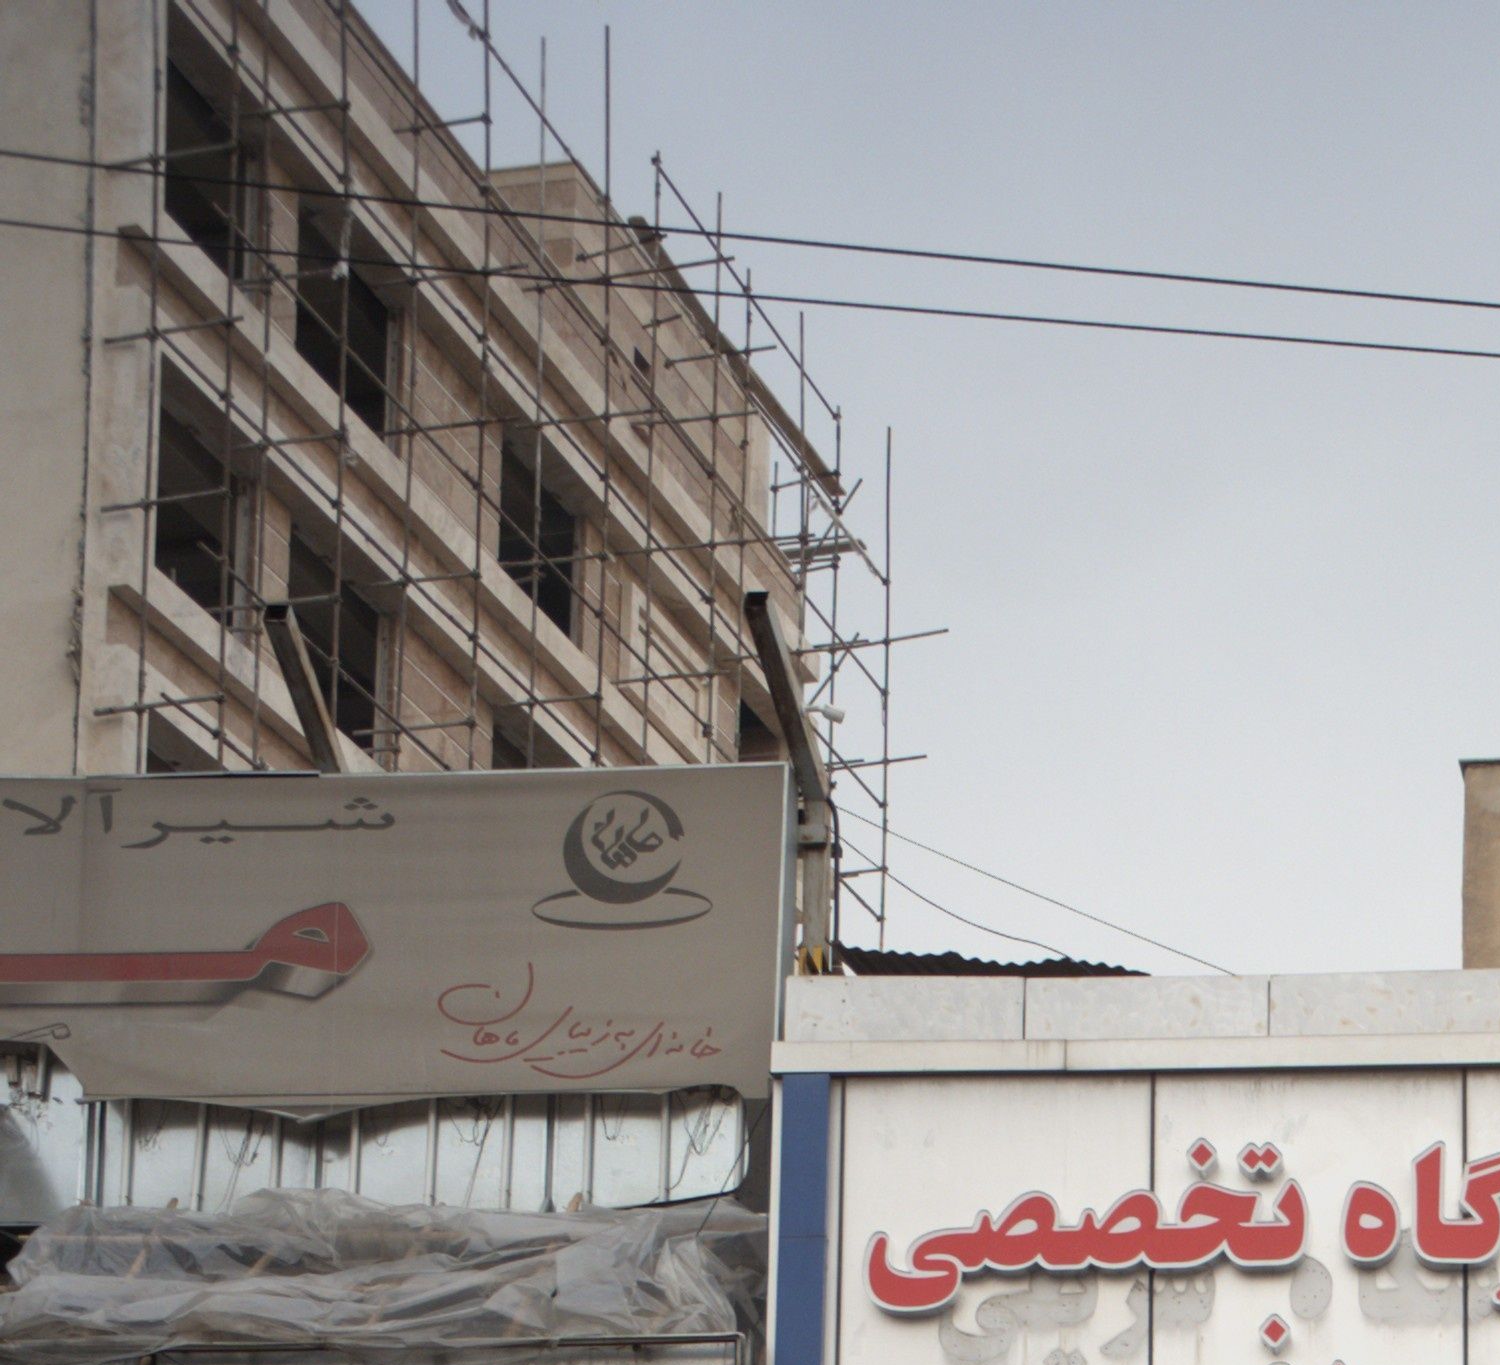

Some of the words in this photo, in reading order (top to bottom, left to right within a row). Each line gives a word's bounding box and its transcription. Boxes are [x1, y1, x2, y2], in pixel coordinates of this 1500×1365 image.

[1, 785, 124, 836] آلا
[119, 796, 397, 850] شیر
[865, 1136, 1311, 1316] تخصصی
